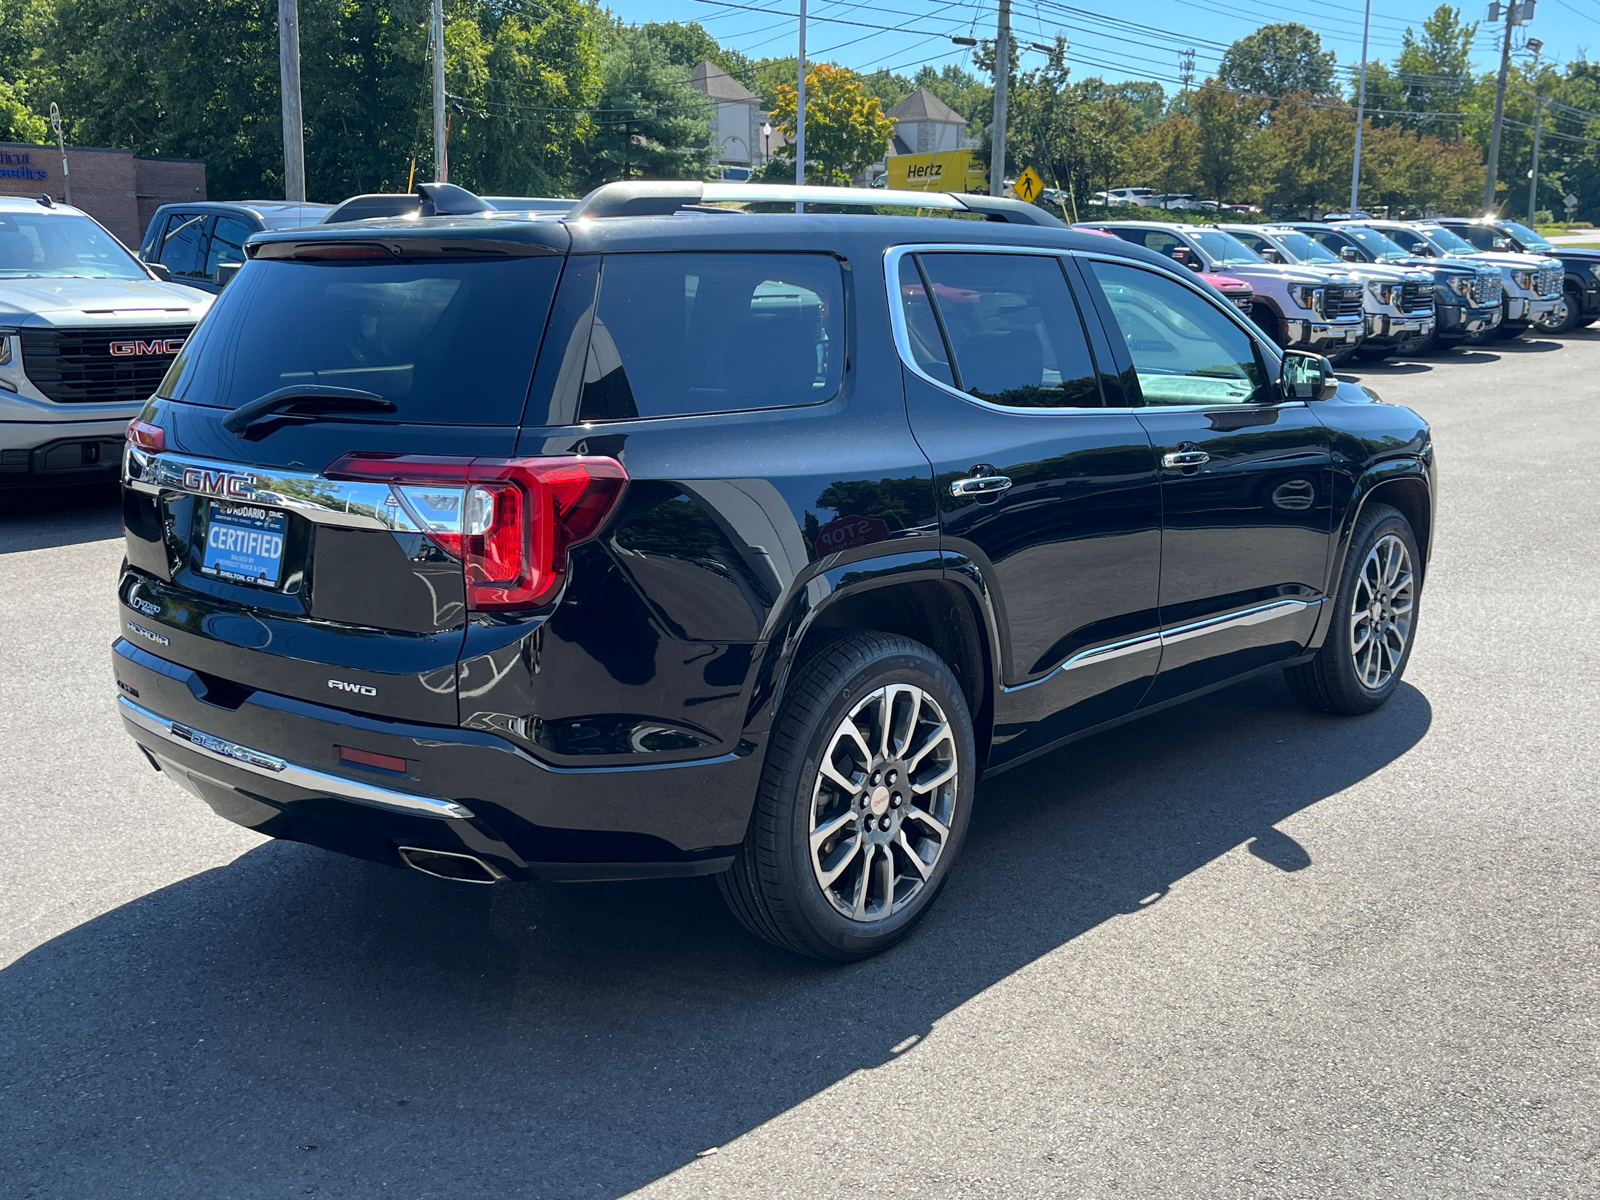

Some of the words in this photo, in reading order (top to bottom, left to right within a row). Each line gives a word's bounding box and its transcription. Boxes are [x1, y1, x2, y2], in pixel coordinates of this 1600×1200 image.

[908, 163, 942, 178] Hertz
[968, 161, 983, 170] Hertz
[109, 339, 185, 356] GMC
[183, 468, 257, 500] GMC
[209, 526, 282, 559] CERTIFIED
[216, 558, 240, 568] CHEVROLET
[230, 554, 248, 562] BACKED
[127, 620, 170, 647] ACADIA
[327, 679, 377, 696] AWD
